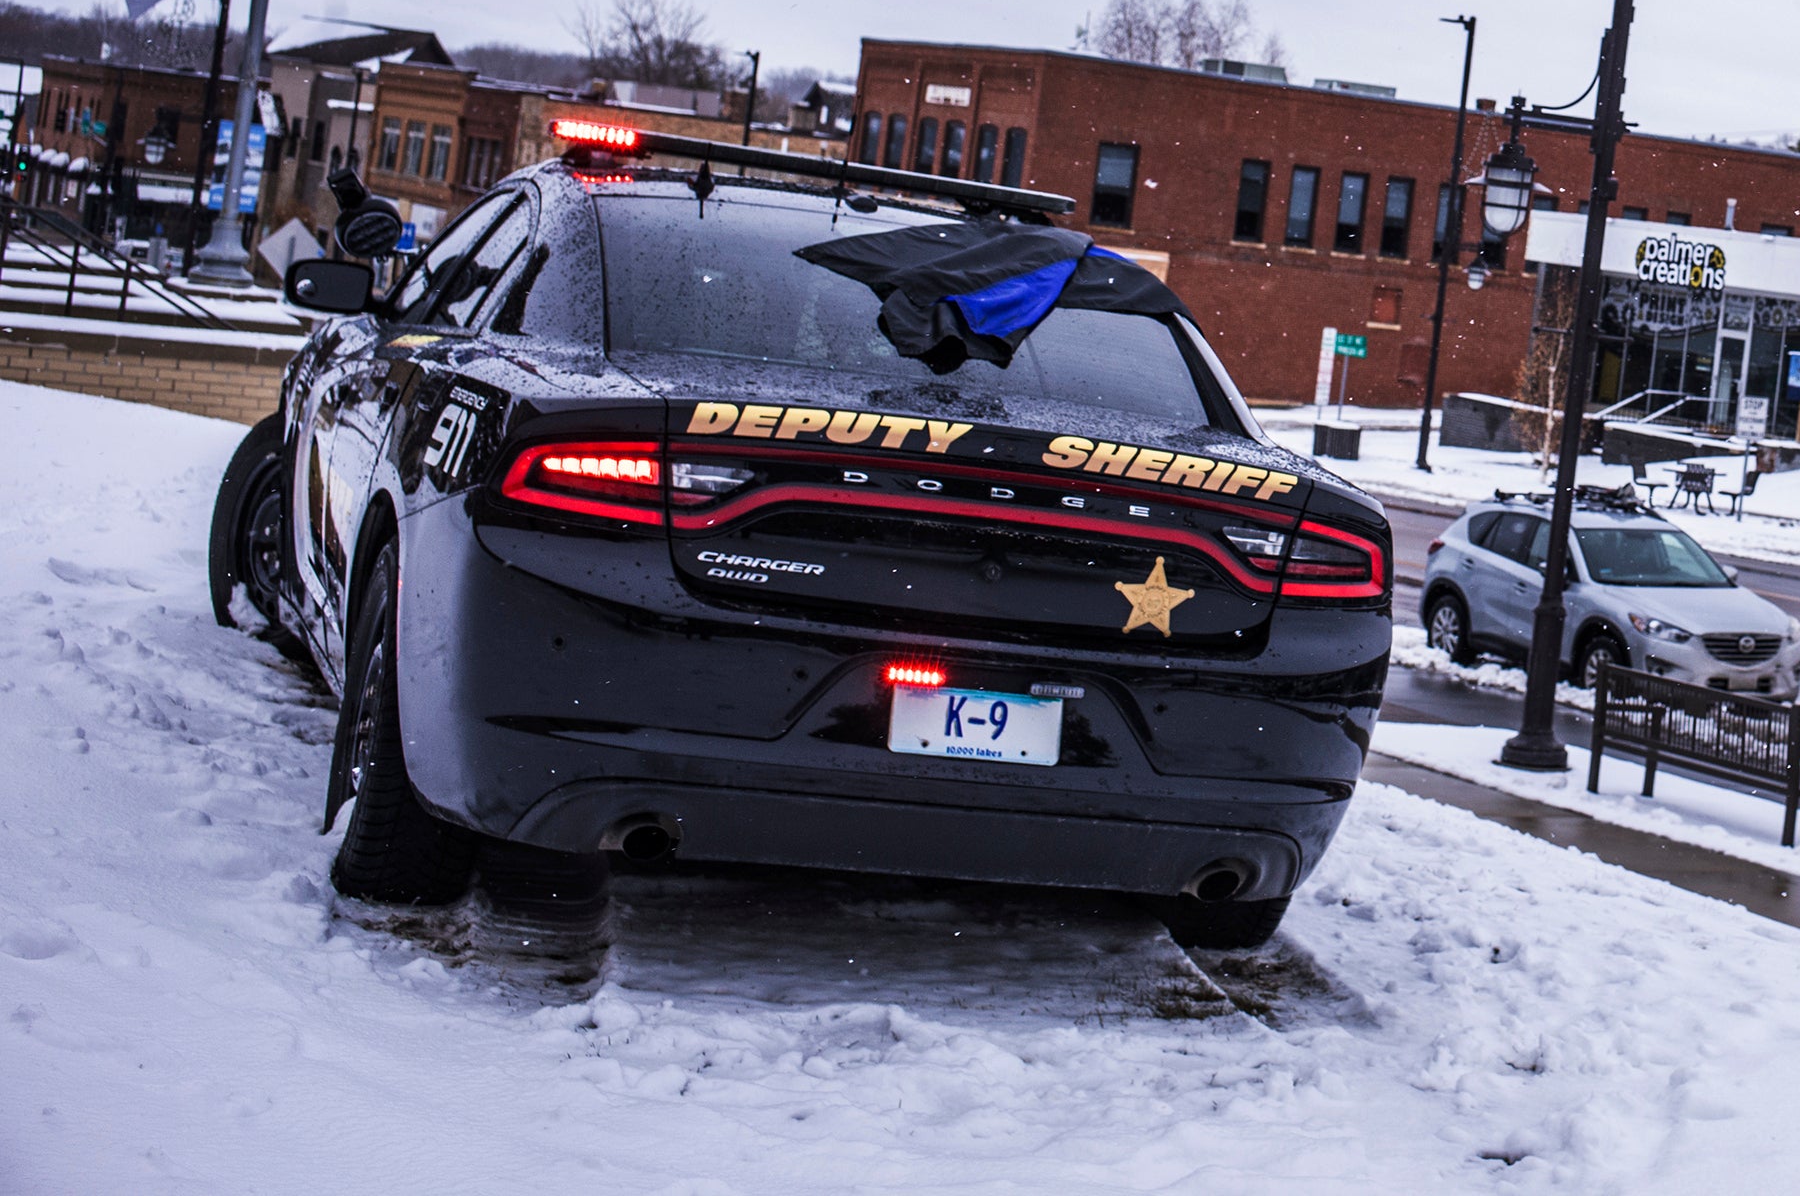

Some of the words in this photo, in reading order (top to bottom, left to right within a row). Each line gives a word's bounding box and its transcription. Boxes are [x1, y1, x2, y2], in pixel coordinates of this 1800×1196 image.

[1644, 233, 1715, 267] palmer
[1638, 260, 1726, 291] creations
[1640, 292, 1686, 312] PRINT
[1743, 399, 1764, 410] STOP
[423, 403, 477, 478] 911
[686, 401, 975, 454] DEPUTY
[1041, 435, 1298, 501] SHERIFF
[843, 470, 1151, 517] DODGE
[697, 550, 825, 576] CHARGER
[706, 567, 769, 583] AWD
[944, 695, 1009, 741] K-9
[975, 747, 1003, 758] lakes
